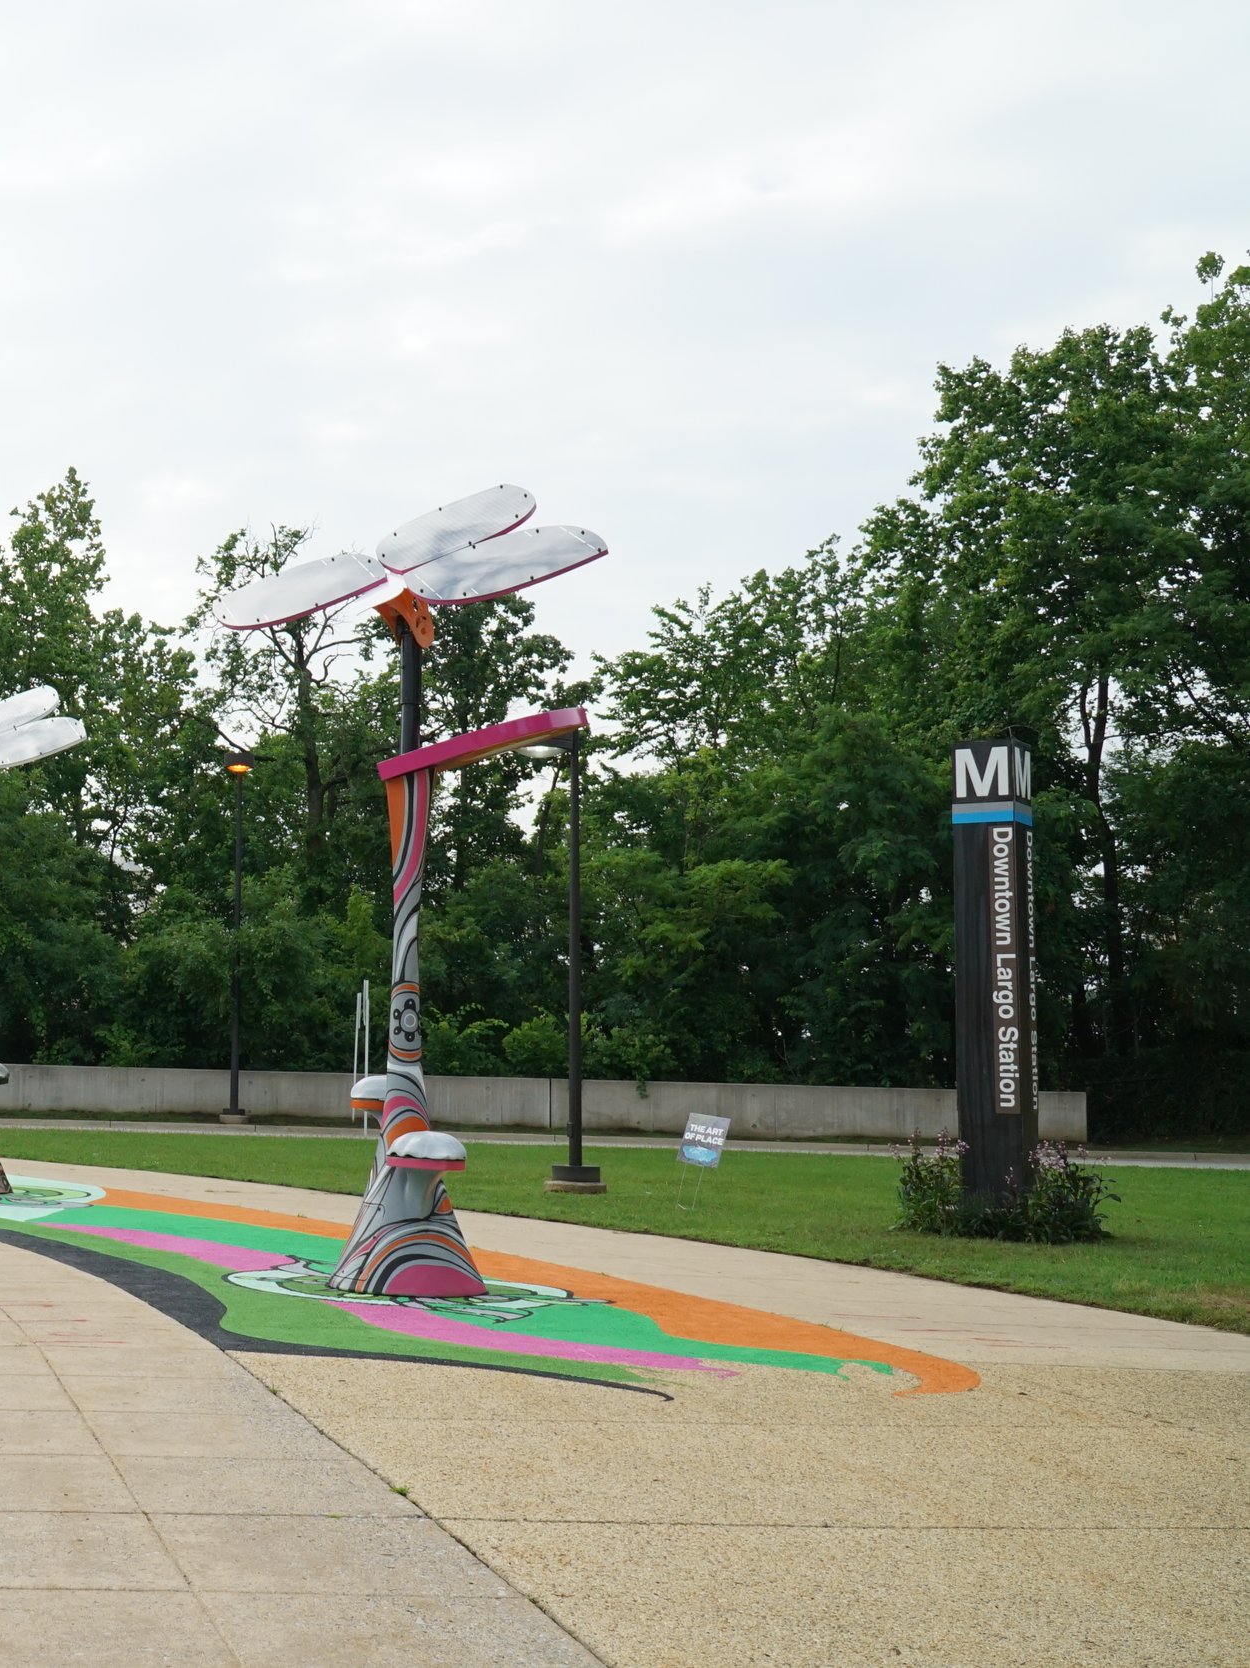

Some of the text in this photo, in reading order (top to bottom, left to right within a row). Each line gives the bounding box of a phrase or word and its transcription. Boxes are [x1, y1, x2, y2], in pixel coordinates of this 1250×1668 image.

[955, 746, 1009, 798] M
[1014, 746, 1031, 800] M
[1026, 831, 1035, 948] Downtown
[992, 826, 1019, 1108] Downtown Largo Station
[1029, 955, 1037, 1021] Largo
[684, 1132, 724, 1146] OF PLACE
[690, 1123, 724, 1136] THE ART
